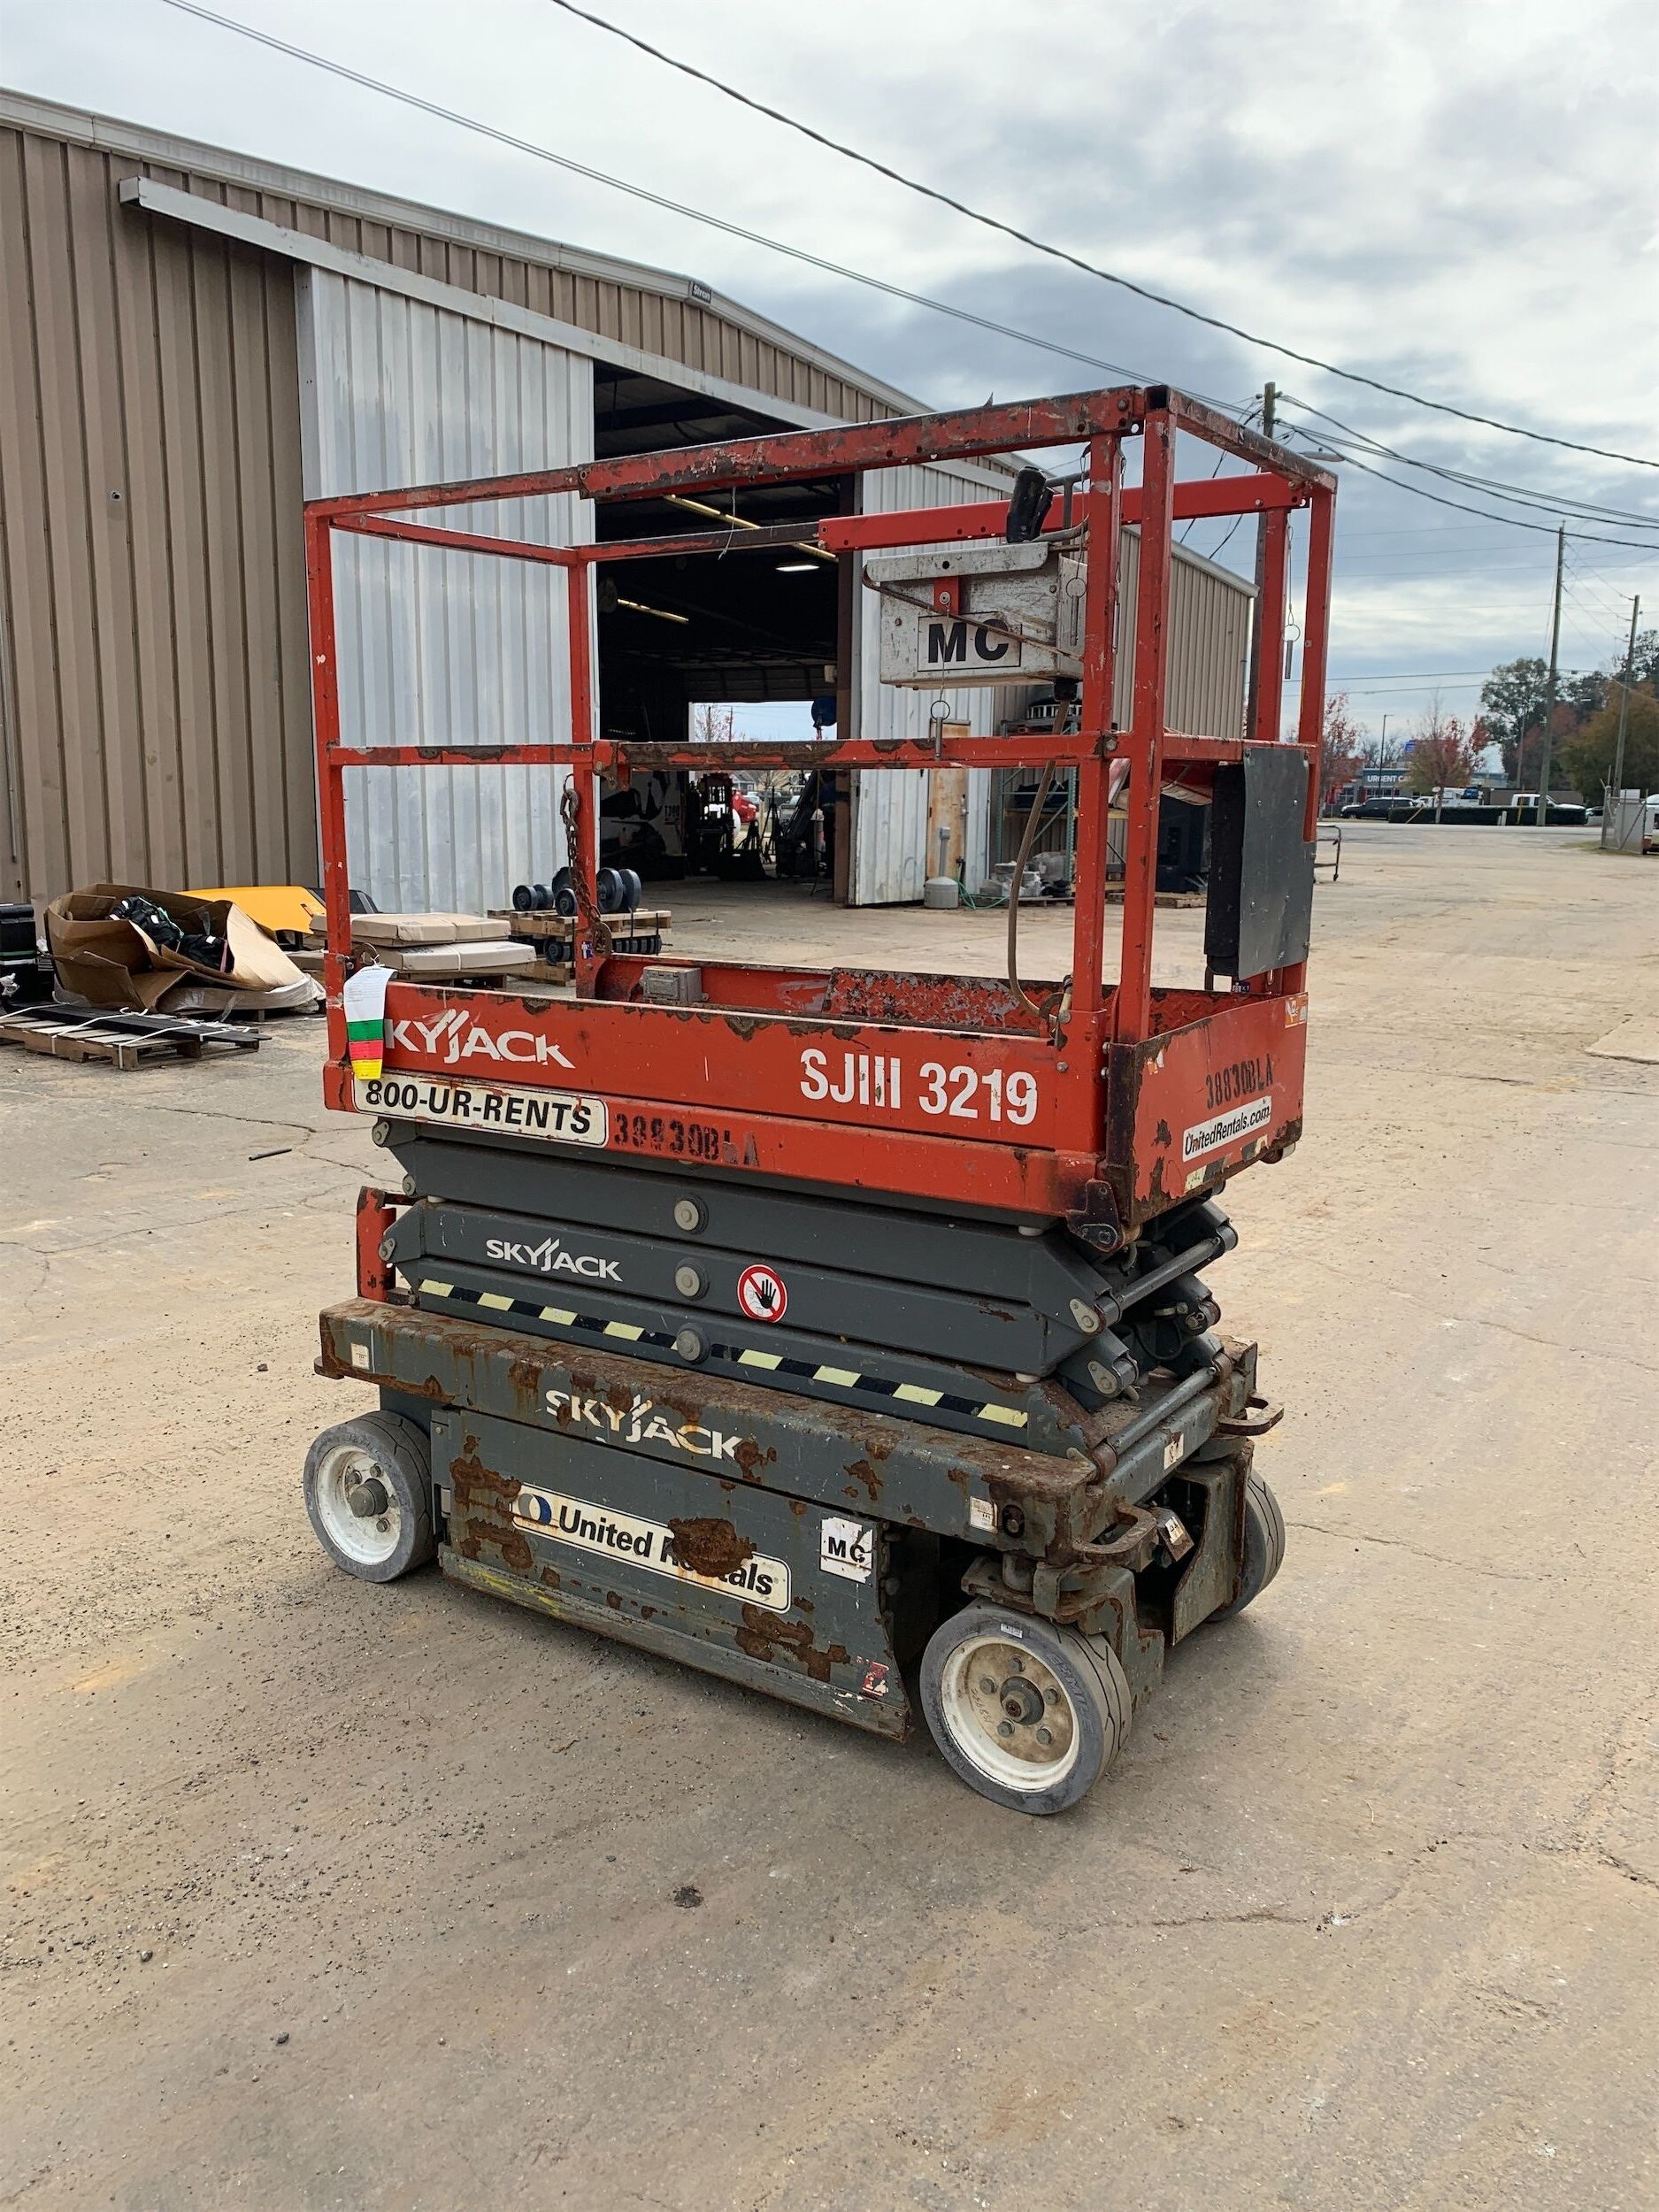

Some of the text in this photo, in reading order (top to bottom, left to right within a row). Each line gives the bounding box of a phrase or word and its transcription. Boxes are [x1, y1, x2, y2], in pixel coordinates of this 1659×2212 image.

[928, 619, 1009, 663] MC
[383, 1008, 576, 1069] KYJACK
[365, 1079, 592, 1134] 800-UR-RENTS
[918, 1062, 1038, 1125] 3219
[1185, 1105, 1271, 1156] UnitedRentals.com
[487, 1238, 623, 1283] SKYJACK
[545, 1389, 743, 1461] SKYJACK
[559, 1505, 773, 1595] United Rals
